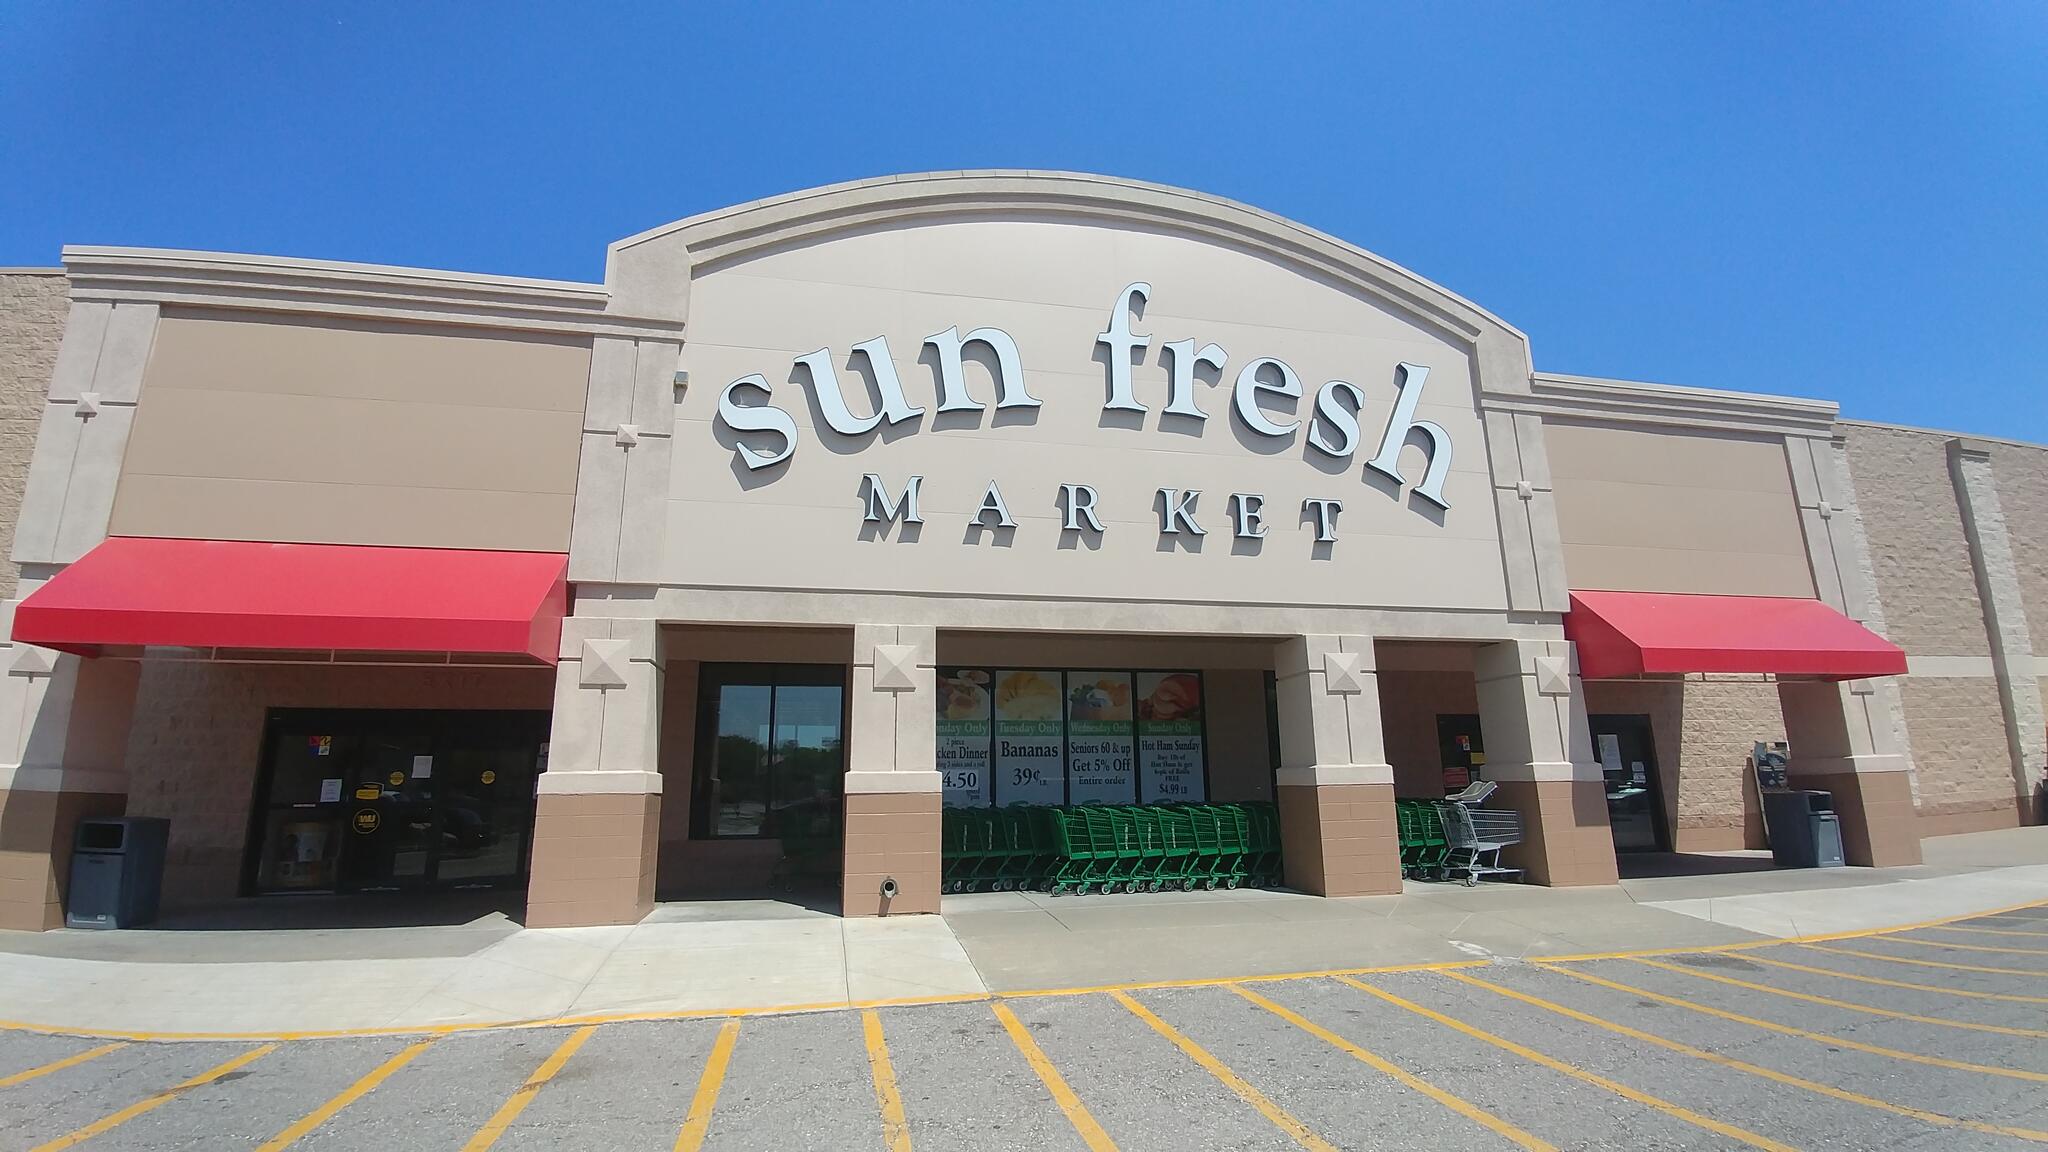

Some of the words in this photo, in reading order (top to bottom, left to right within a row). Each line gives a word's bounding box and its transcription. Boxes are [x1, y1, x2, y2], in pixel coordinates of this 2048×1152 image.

[718, 325, 1043, 470] sun
[1099, 282, 1453, 510] fresh
[863, 473, 1343, 543] MARKET
[964, 722, 988, 735] Only
[999, 722, 1034, 735] Tuesday
[1038, 722, 1060, 735] Only
[1070, 722, 1111, 735] Wednesday
[1112, 722, 1130, 734] Only
[937, 747, 956, 759] cken
[959, 746, 988, 759] Dinner
[1001, 741, 1058, 757] Bananas
[1070, 741, 1099, 754] Seniors
[1100, 742, 1110, 754] 60
[1112, 742, 1119, 754] &
[1120, 746, 1131, 757] up
[1141, 740, 1155, 751] Hot
[1157, 740, 1173, 751] Ham
[1174, 739, 1200, 753] Sunday
[1072, 758, 1090, 771] Get
[1094, 758, 1110, 771] 5%
[1113, 758, 1131, 771] Off
[1078, 776, 1103, 784] Entire
[1104, 776, 1126, 784] order
[1159, 783, 1179, 794] $4.99
